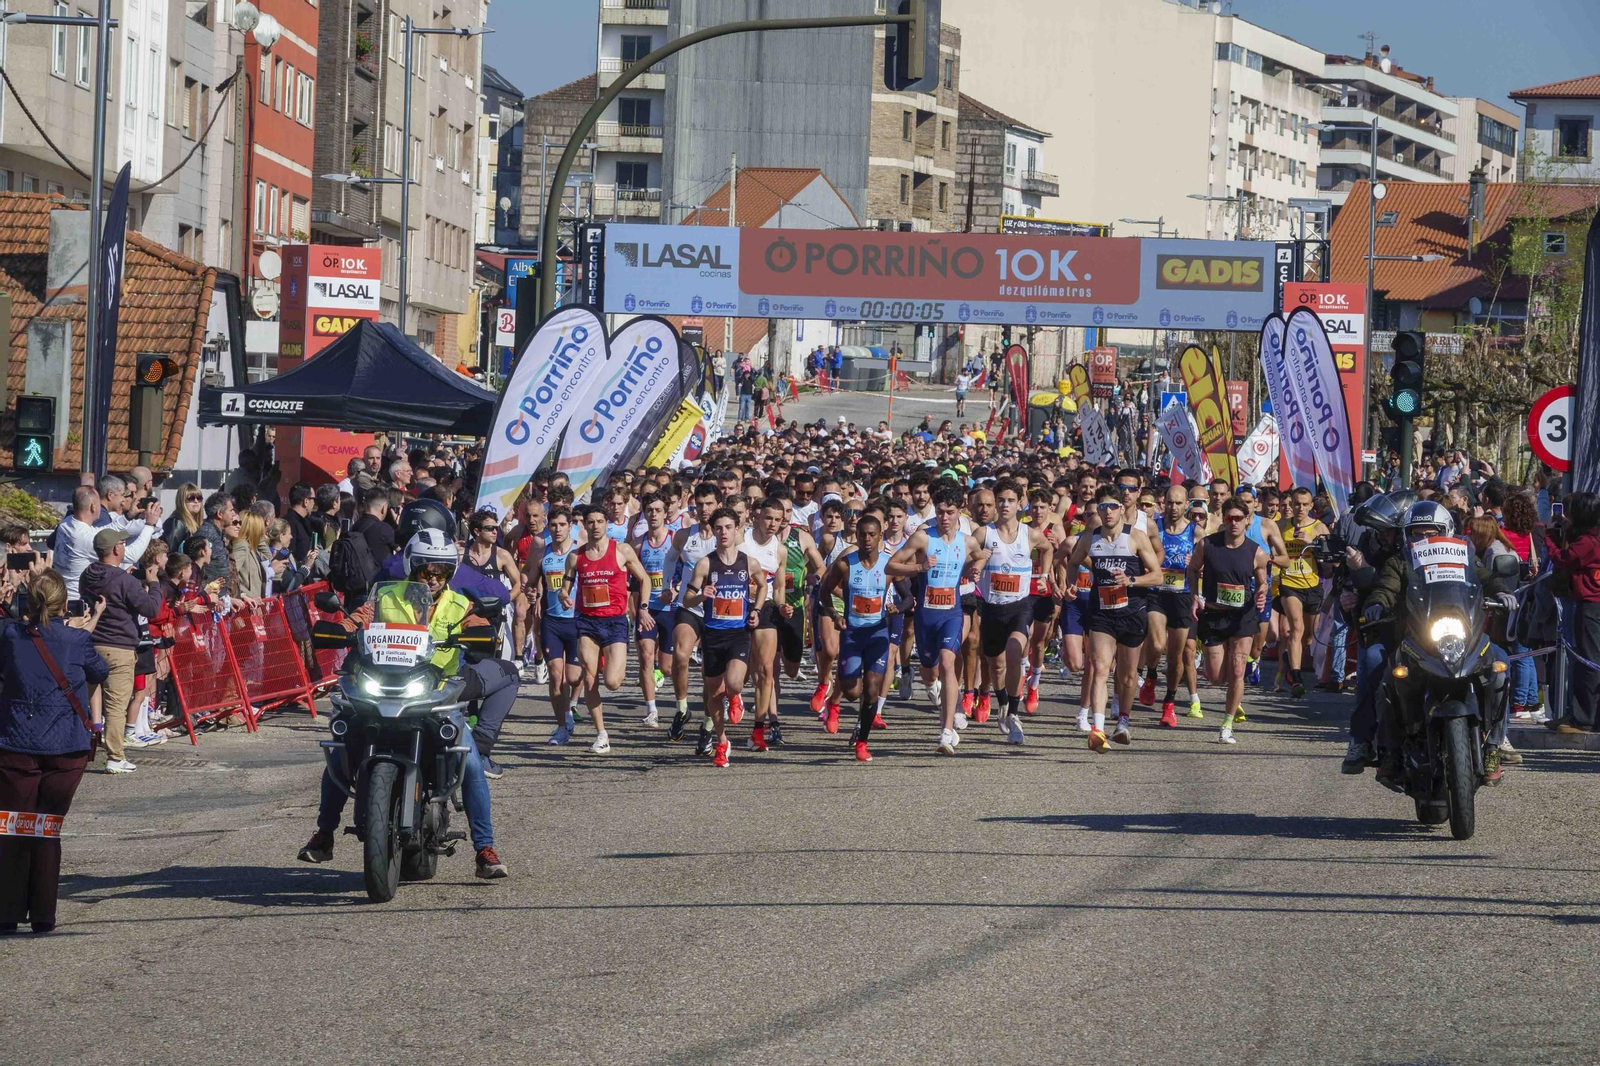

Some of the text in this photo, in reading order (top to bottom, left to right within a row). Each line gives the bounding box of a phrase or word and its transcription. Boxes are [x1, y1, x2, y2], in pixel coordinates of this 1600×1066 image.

[642, 243, 732, 270] LASAL
[804, 238, 984, 280] PORRIÑO
[994, 248, 1092, 282] 10K.
[512, 262, 534, 272] Alb
[700, 269, 732, 278] cocinas
[1162, 258, 1260, 286] GADIS
[588, 245, 597, 305] CCNORTE
[328, 283, 374, 300] LASAL
[999, 284, 1092, 298] dezquilómetros
[860, 300, 945, 320] 00:00:05
[316, 316, 360, 334] GAD
[1325, 320, 1357, 334] SAL
[1336, 353, 1354, 370] IS
[518, 325, 588, 420] Porriño
[593, 334, 662, 422] Porriño
[653, 382, 675, 410] cocinas
[1093, 388, 1112, 396] 2026
[248, 399, 304, 411] CCNORTE
[1232, 410, 1244, 422] K.
[1546, 414, 1568, 442] 3
[327, 445, 360, 456] CEAMSA
[1413, 546, 1466, 560] ORGANIZACIÓN
[553, 578, 562, 588] 10
[995, 580, 1016, 591] 2001
[1165, 575, 1176, 586] 32
[716, 588, 746, 598] ARÓN
[928, 594, 952, 605] 2005
[1221, 590, 1242, 603] 2243
[724, 605, 730, 616] 4
[864, 604, 870, 614] 3
[385, 655, 413, 664] feminina
